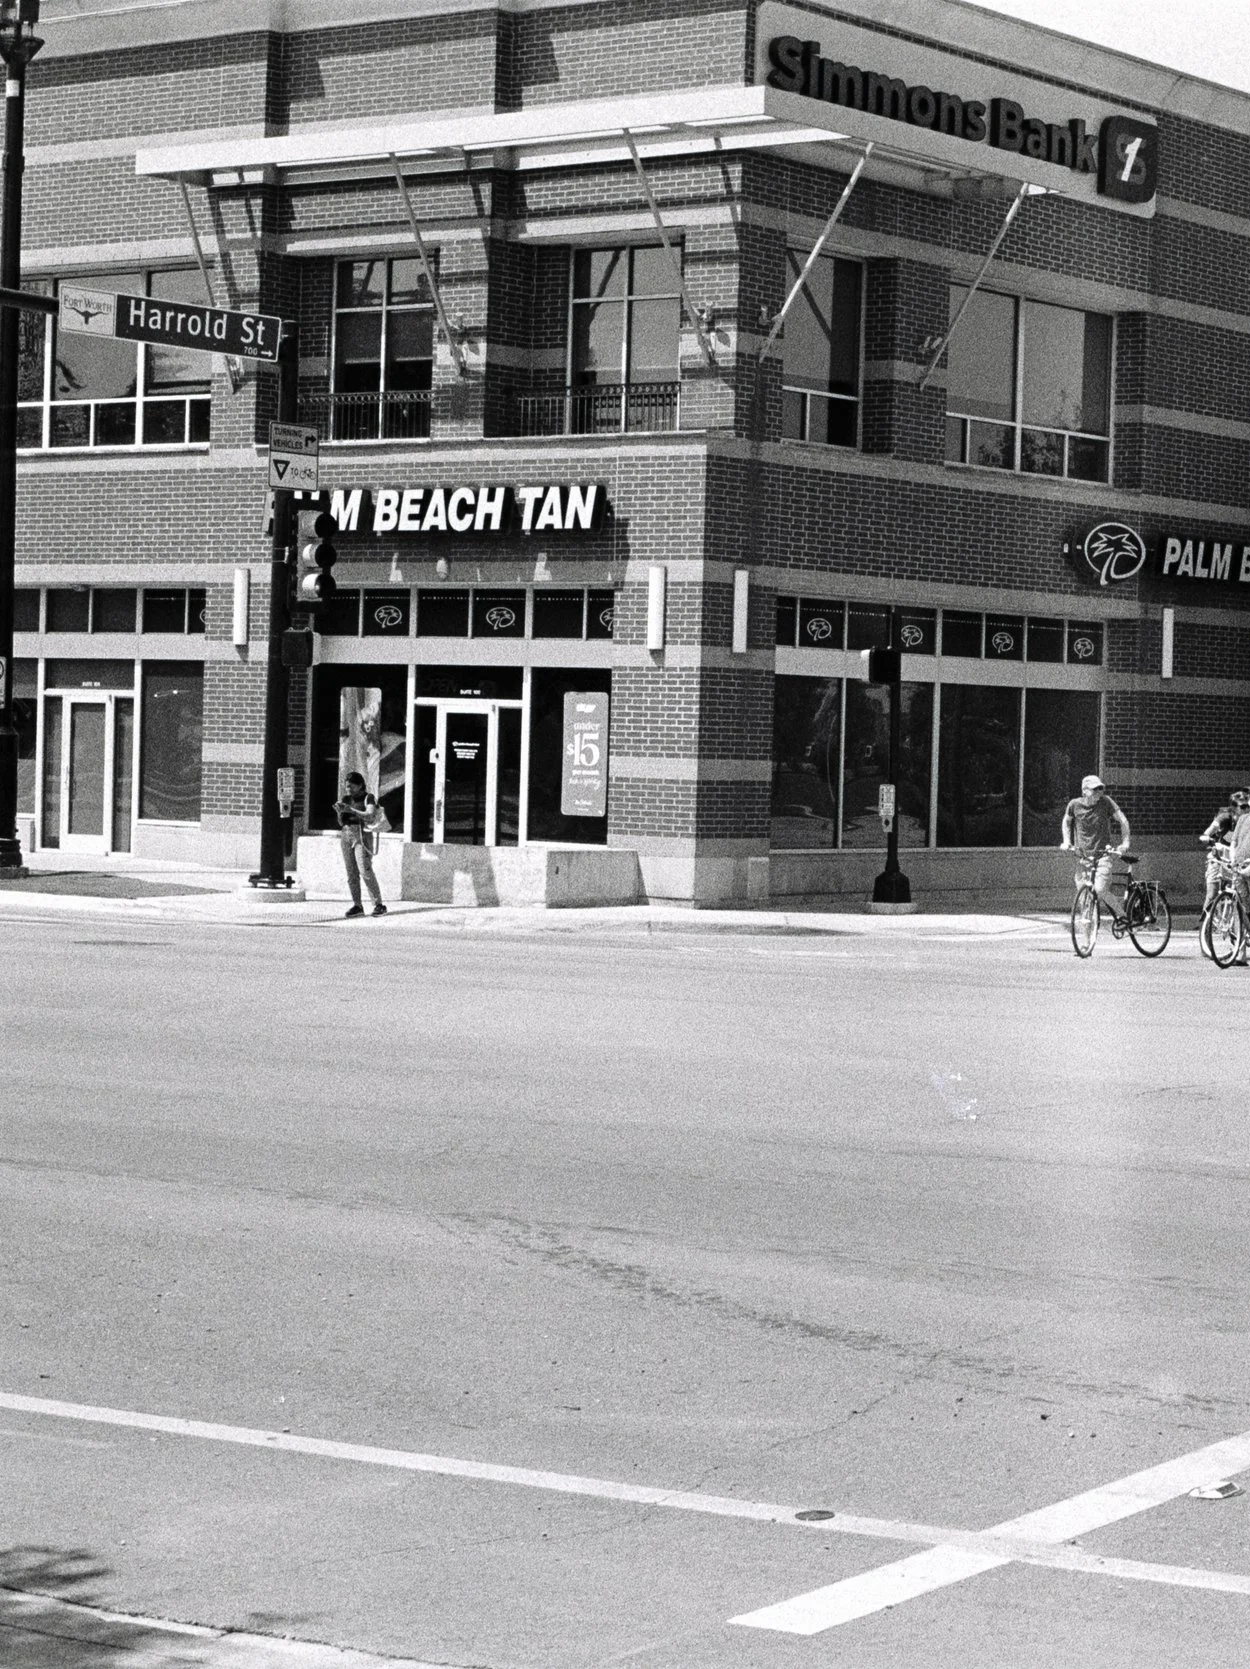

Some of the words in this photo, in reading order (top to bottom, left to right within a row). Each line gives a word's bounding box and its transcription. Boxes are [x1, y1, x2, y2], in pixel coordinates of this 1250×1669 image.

[766, 34, 987, 142] Simmons
[988, 96, 1098, 174] Bank
[63, 294, 82, 307] FORT
[82, 297, 113, 313] WORTH
[129, 299, 228, 340] Harrold
[240, 317, 266, 346] St
[243, 346, 258, 356] 700
[273, 438, 304, 450] VEHICLES
[274, 427, 302, 438] TURNING
[290, 467, 299, 477] TO
[373, 486, 505, 532] BEACH
[519, 485, 597, 531] TAN
[1162, 537, 1233, 580] PALM
[566, 732, 600, 767] $15
